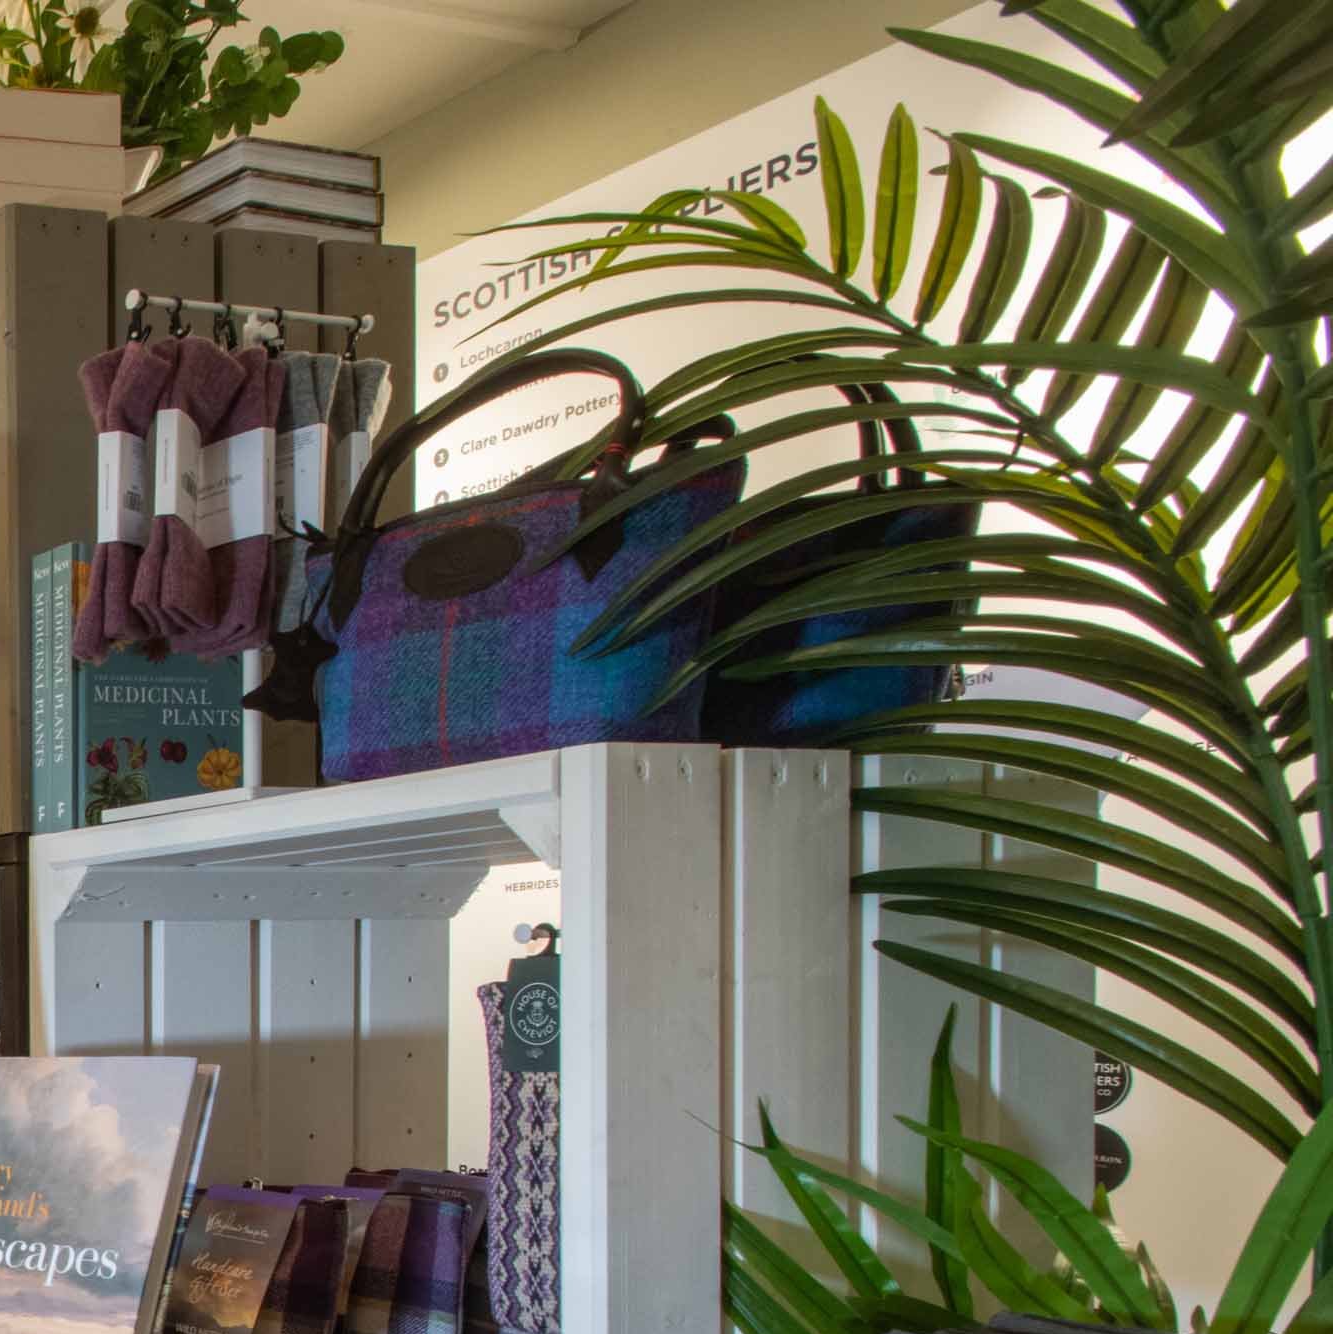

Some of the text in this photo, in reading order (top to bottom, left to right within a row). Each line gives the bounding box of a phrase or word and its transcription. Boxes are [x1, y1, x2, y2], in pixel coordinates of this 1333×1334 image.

[433, 239, 593, 329] SCOTTISH
[460, 326, 544, 369] Lochcarron
[460, 433, 498, 455] Clare
[502, 411, 560, 442] Dawdry
[93, 685, 213, 706] MEDICINAL
[35, 699, 45, 768] PLANTS
[54, 693, 64, 763] PLANTS
[161, 708, 241, 727] PLANTS
[505, 879, 559, 894] HEBRIDES
[517, 988, 547, 1013] HOUSE
[516, 1016, 558, 1040] CHEVIOT
